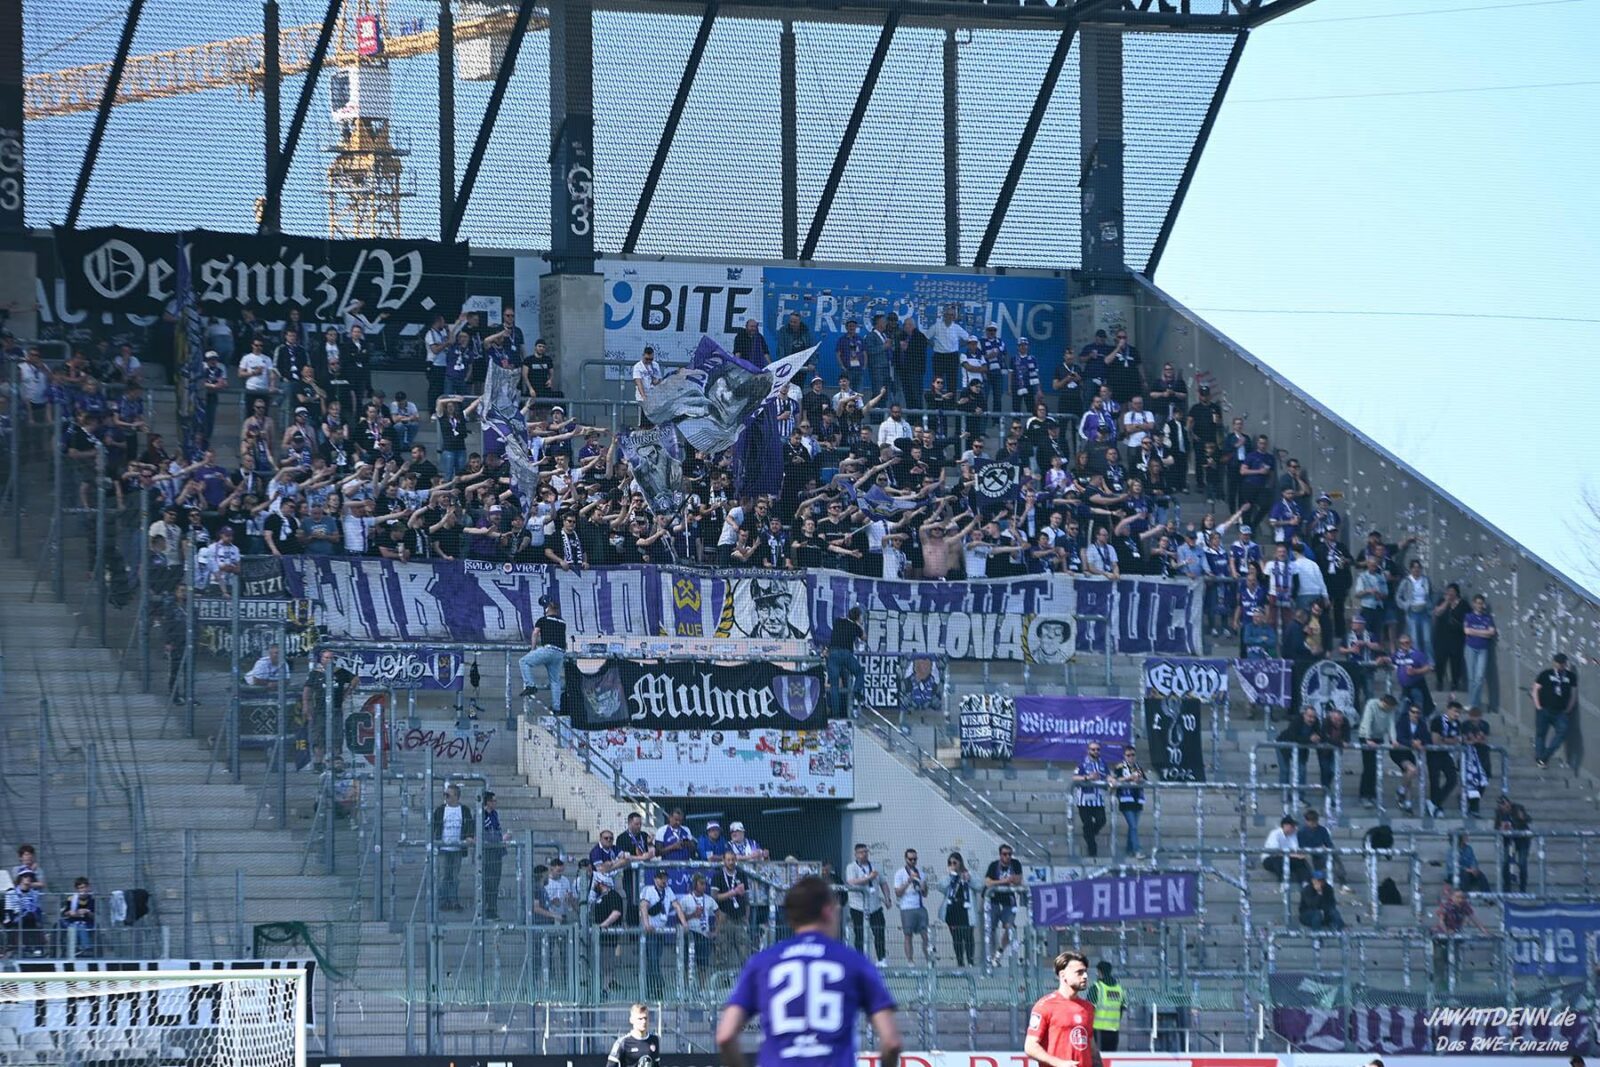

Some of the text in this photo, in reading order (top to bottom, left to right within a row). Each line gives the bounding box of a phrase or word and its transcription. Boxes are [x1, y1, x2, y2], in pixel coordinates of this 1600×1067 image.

[641, 284, 753, 334] BITE
[243, 575, 283, 596] JETZT
[678, 622, 703, 636] AUE
[866, 610, 1027, 661] FIALOVA
[628, 671, 778, 726] Muhme
[1019, 712, 1127, 737] Wismutadler
[1039, 877, 1186, 923] PLAUEN
[768, 960, 845, 1035] 26
